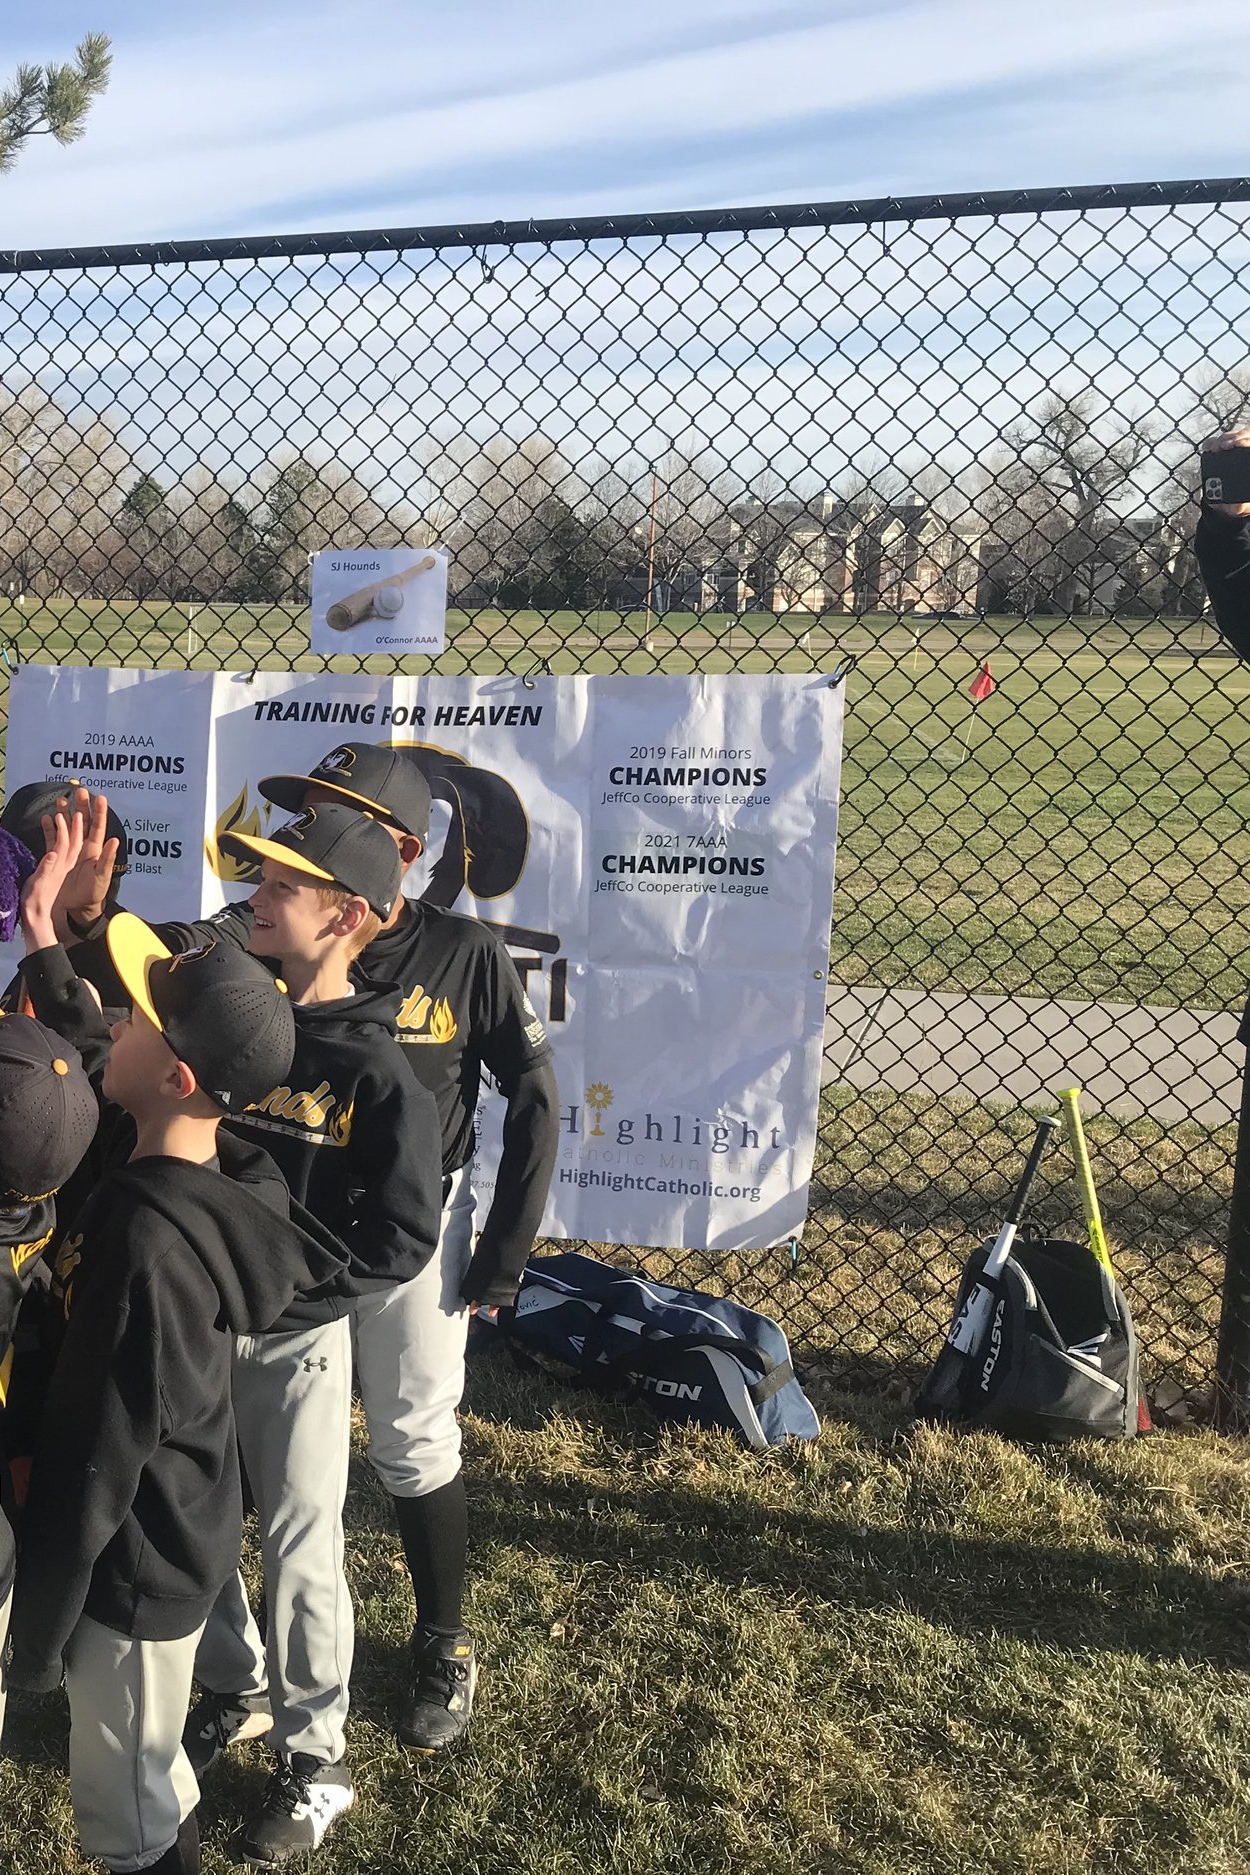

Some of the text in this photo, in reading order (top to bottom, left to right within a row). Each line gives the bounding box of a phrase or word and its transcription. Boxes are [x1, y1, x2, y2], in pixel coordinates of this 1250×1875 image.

[330, 561, 381, 571] SJ Hounds
[375, 636, 438, 644] O'Connor AAAA
[254, 701, 542, 727] TRAINING FOR HEAVEN
[84, 733, 155, 748] 2019 AAAA
[49, 750, 185, 775] CHAMPIONS
[629, 746, 752, 760] 2019 Fall Minors
[79, 775, 144, 793] Cooperative
[147, 780, 188, 794] League
[609, 766, 767, 787] CHAMPIONS
[601, 792, 771, 808] JeffCo Cooperative League
[134, 819, 171, 833] Silver
[644, 834, 728, 849] 2021 7AAA
[135, 863, 162, 875] Blast
[601, 854, 765, 876] CHAMPIONS
[594, 879, 769, 898] JeffCo Cooperative League
[562, 1146, 646, 1166] atholic
[559, 1168, 762, 1203] HighlightCatholic.org
[980, 1298, 1006, 1392] EASTON
